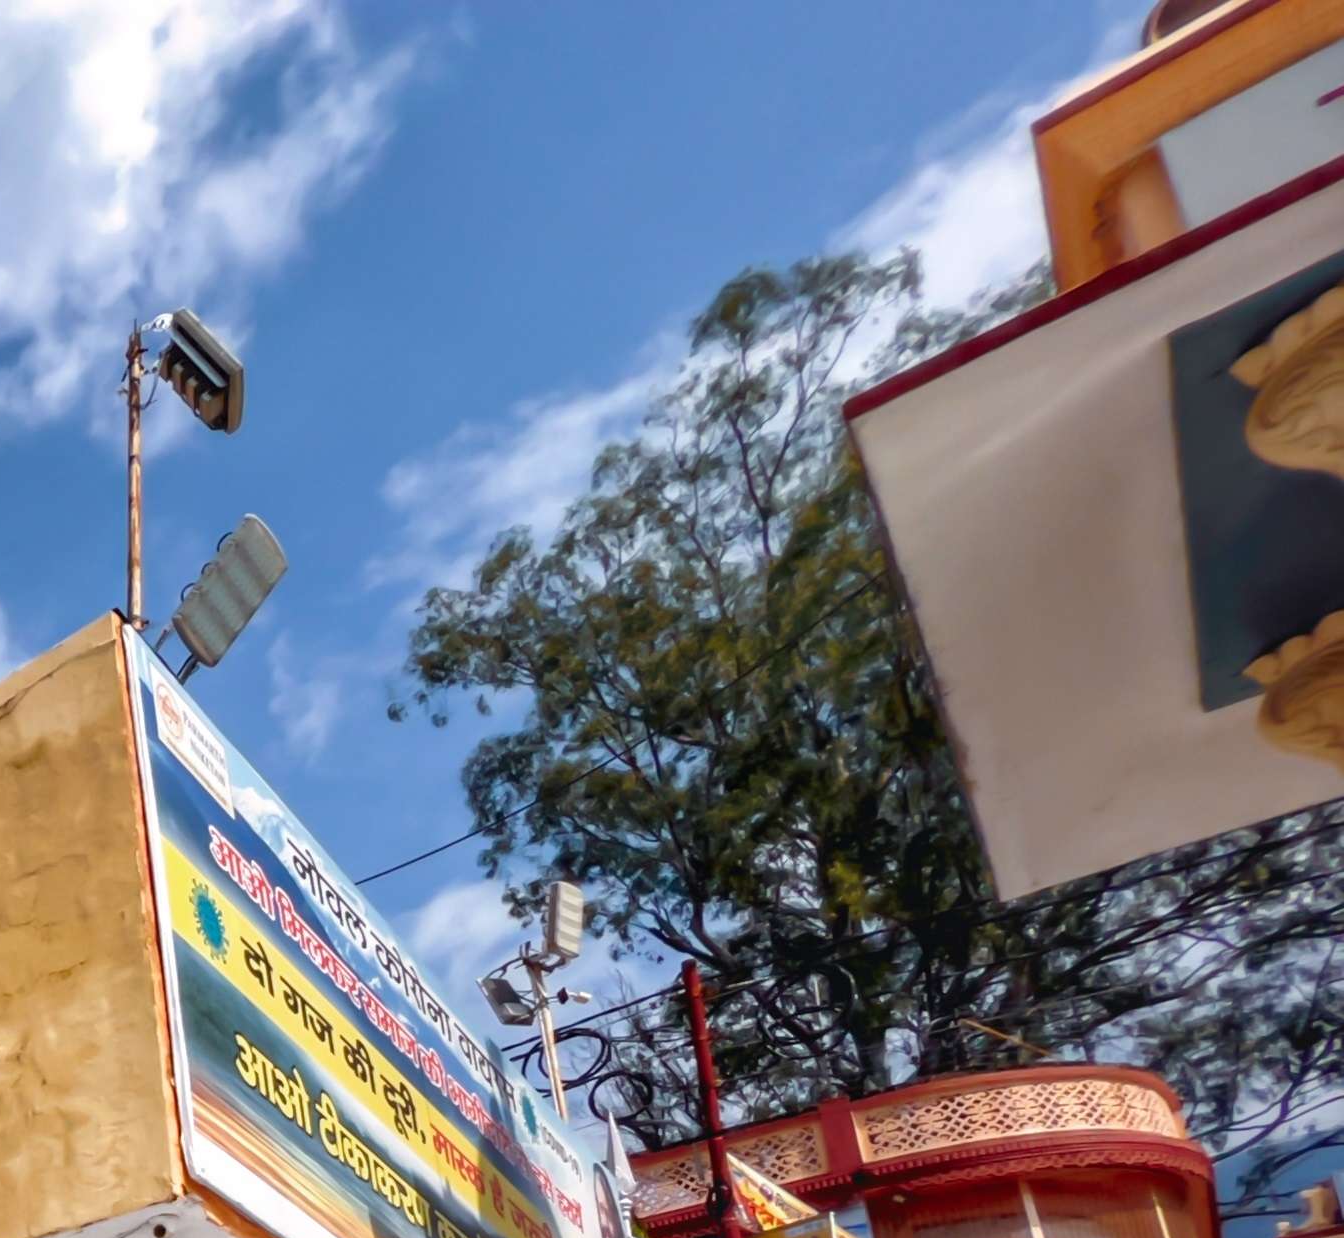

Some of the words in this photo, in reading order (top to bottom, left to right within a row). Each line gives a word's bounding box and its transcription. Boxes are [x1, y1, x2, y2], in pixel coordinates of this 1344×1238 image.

[210, 826, 275, 920] आओ
[276, 888, 362, 1010] मिलकर
[361, 982, 420, 1068] समाज
[418, 1047, 448, 1096] की
[240, 936, 274, 998] दो
[280, 976, 335, 1055] गज
[340, 1035, 376, 1094] की
[380, 1075, 426, 1145] दूरी,
[430, 1122, 486, 1195] मास्क
[491, 1173, 504, 1219] है
[287, 838, 367, 949] नोवल
[370, 931, 452, 1042] कोरोना
[454, 1022, 517, 1113] वायरस
[234, 1032, 312, 1136] आओ
[315, 1091, 432, 1237] टीकाकरण
